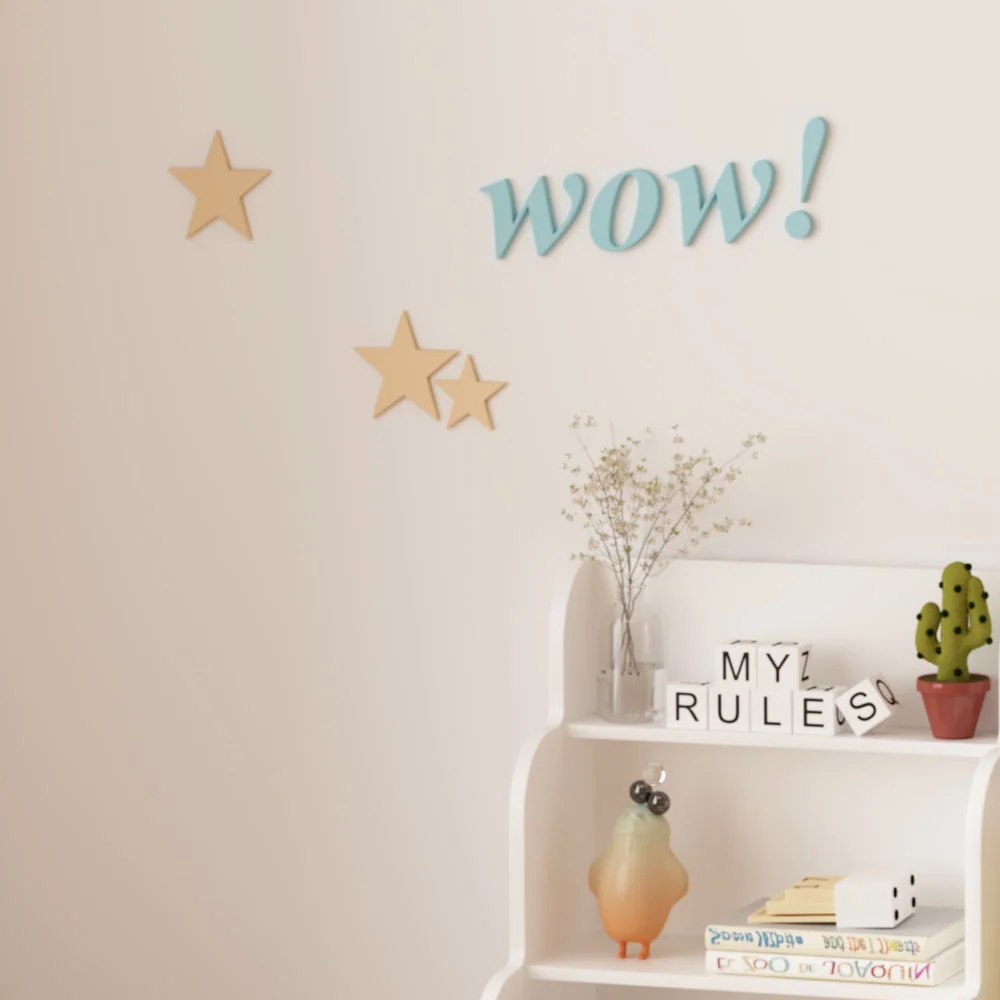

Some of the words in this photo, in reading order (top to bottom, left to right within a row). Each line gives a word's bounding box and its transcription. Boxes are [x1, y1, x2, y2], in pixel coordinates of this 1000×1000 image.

[480, 115, 829, 260] wow!
[722, 651, 790, 683] MY
[675, 691, 878, 728] RULES
